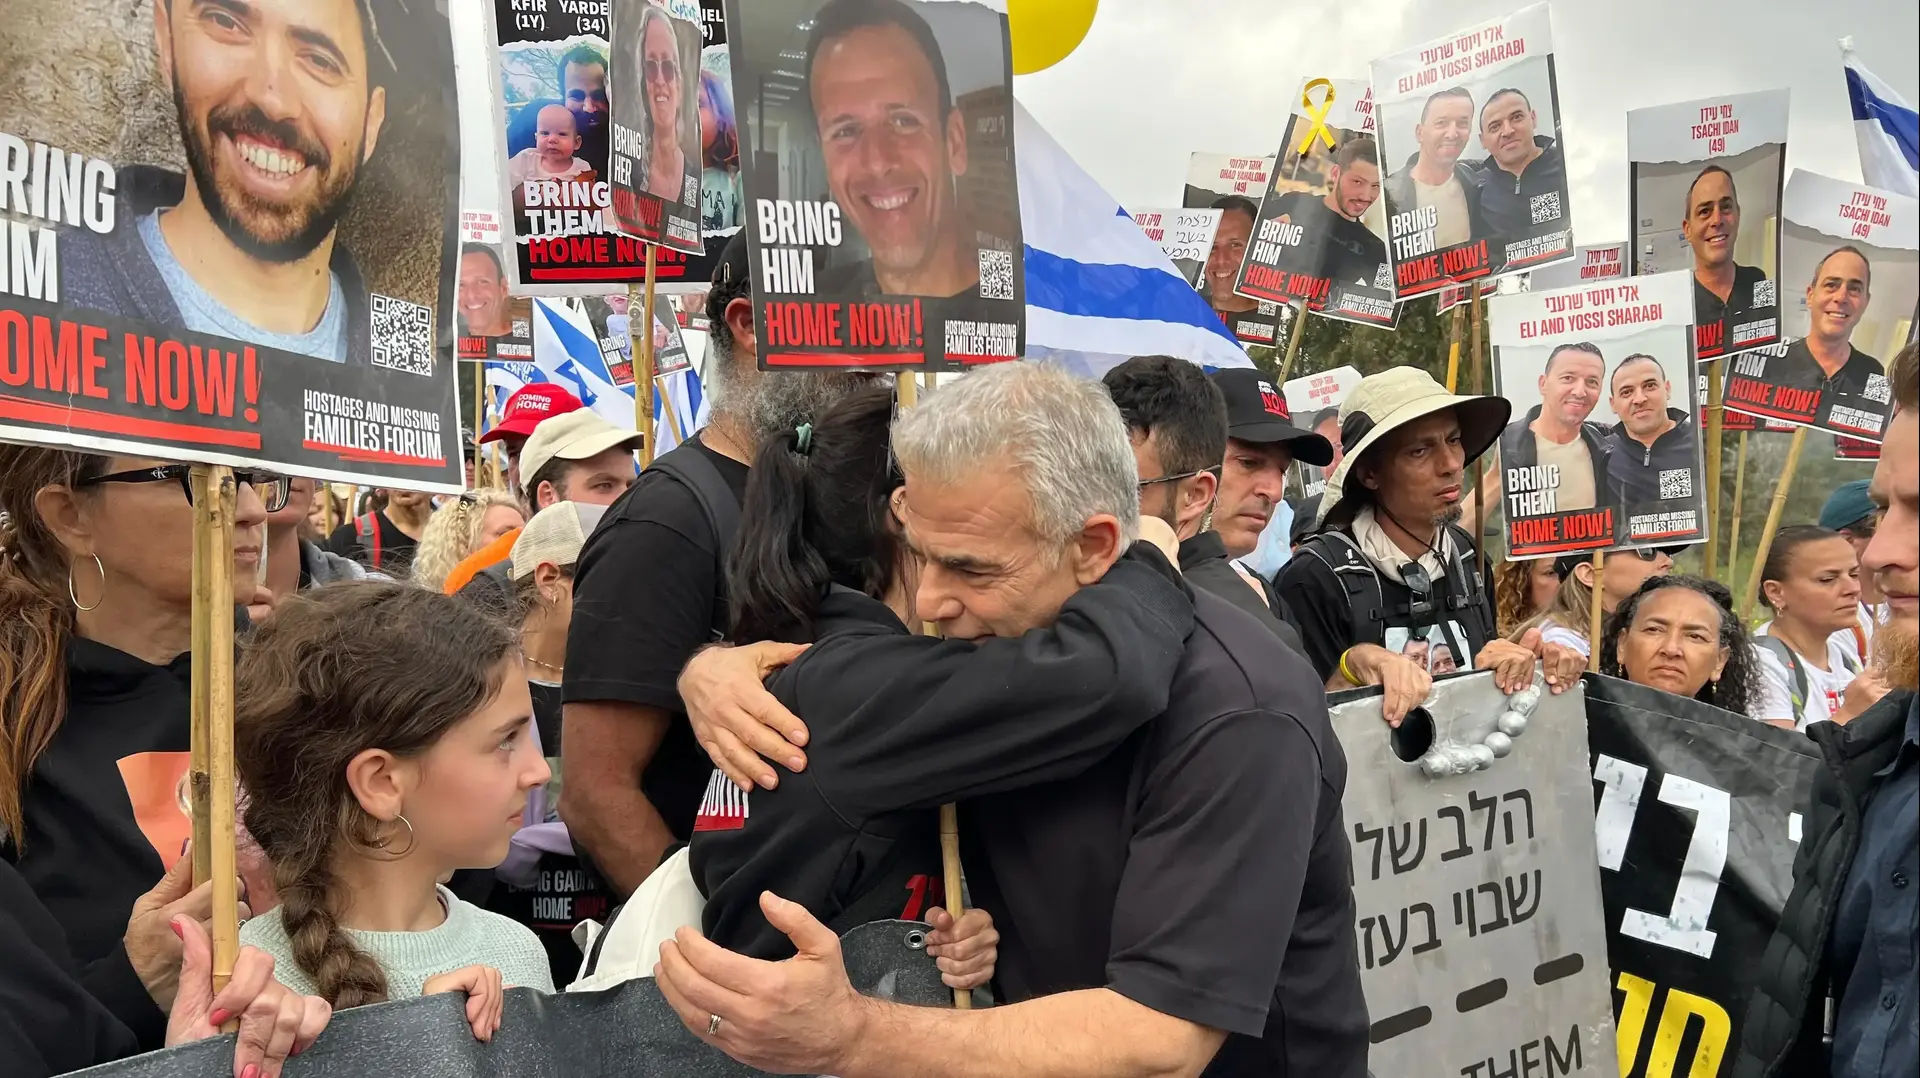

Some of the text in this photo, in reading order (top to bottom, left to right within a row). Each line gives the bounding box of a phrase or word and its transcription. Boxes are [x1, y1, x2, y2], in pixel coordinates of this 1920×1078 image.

[511, 0, 547, 12] KFIR
[515, 15, 545, 31] (1Y)
[576, 17, 606, 34] (34)
[1484, 25, 1503, 43] אלי
[1456, 32, 1481, 53] ויוסי
[1398, 76, 1413, 94] ELI
[1416, 68, 1438, 88] AND
[1440, 56, 1472, 79] YOSSI
[1474, 38, 1525, 68] SHARABI
[1701, 104, 1732, 124] צחי עידן
[614, 123, 642, 160] BRING
[1691, 119, 1739, 140] TSACHI IDAN
[1709, 137, 1725, 155] (49)
[614, 153, 632, 187] HER
[1219, 169, 1267, 183] OHAD YAHALOMI
[524, 181, 609, 207] BRING
[1233, 182, 1247, 194] (49)
[1851, 191, 1888, 211] צחי עידן
[524, 209, 604, 235] THEM
[757, 198, 842, 246] BRING
[1391, 206, 1437, 237] BRING
[1838, 203, 1892, 228] TSACHI IDAN
[1258, 218, 1304, 247] BRING
[1851, 221, 1871, 239] (49)
[528, 237, 688, 263] HOME NOW
[1251, 240, 1282, 266] HIM
[1393, 229, 1437, 261] THEM
[1505, 239, 1532, 252] HOSTAGES
[1531, 236, 1543, 246] AND
[1506, 238, 1568, 263] FAMILIES FORUM
[761, 247, 815, 294] HIM
[1396, 239, 1488, 287] HOME NOW!
[1580, 262, 1622, 279] OMRI MIRAN
[1244, 263, 1332, 302] HOME NOW!
[1339, 300, 1394, 319] FAMILIES FORUM
[1545, 285, 1640, 314] אלי ויוסי שרעבי
[765, 298, 924, 347] HOME NOW!
[944, 319, 1017, 339] HOSTAGES AND MISSING
[1520, 303, 1663, 339] ELI AND YOSSI SHARABI
[458, 336, 487, 352] NOW!
[600, 335, 626, 352] BRING
[945, 334, 1017, 357] FAMILIES FORUM
[1733, 324, 1777, 345] FAMILIES FORUM
[604, 350, 623, 366] HIM
[1734, 352, 1767, 378] HIM
[124, 333, 262, 422] NOW!
[516, 401, 551, 411] HOME
[518, 393, 552, 403] COMING
[1729, 377, 1774, 405] HOME
[1772, 385, 1822, 415] NOW!
[304, 388, 440, 432] HOSTAGES AND MISSING
[1829, 411, 1883, 433] FAMILIES FORUM
[304, 411, 443, 460] FAMILIES FORUM
[1305, 479, 1328, 498] BRING
[1507, 463, 1560, 493] BRING
[1508, 490, 1557, 518] THEM
[1630, 509, 1696, 524] HOSTAGES AND MISSING
[1511, 508, 1614, 545] HOME NOW!
[1630, 518, 1697, 536] FAMILIES FORUM
[1354, 788, 1535, 881] הלב של
[532, 897, 573, 920] HOME
[1359, 869, 1542, 970] שבוי בעז
